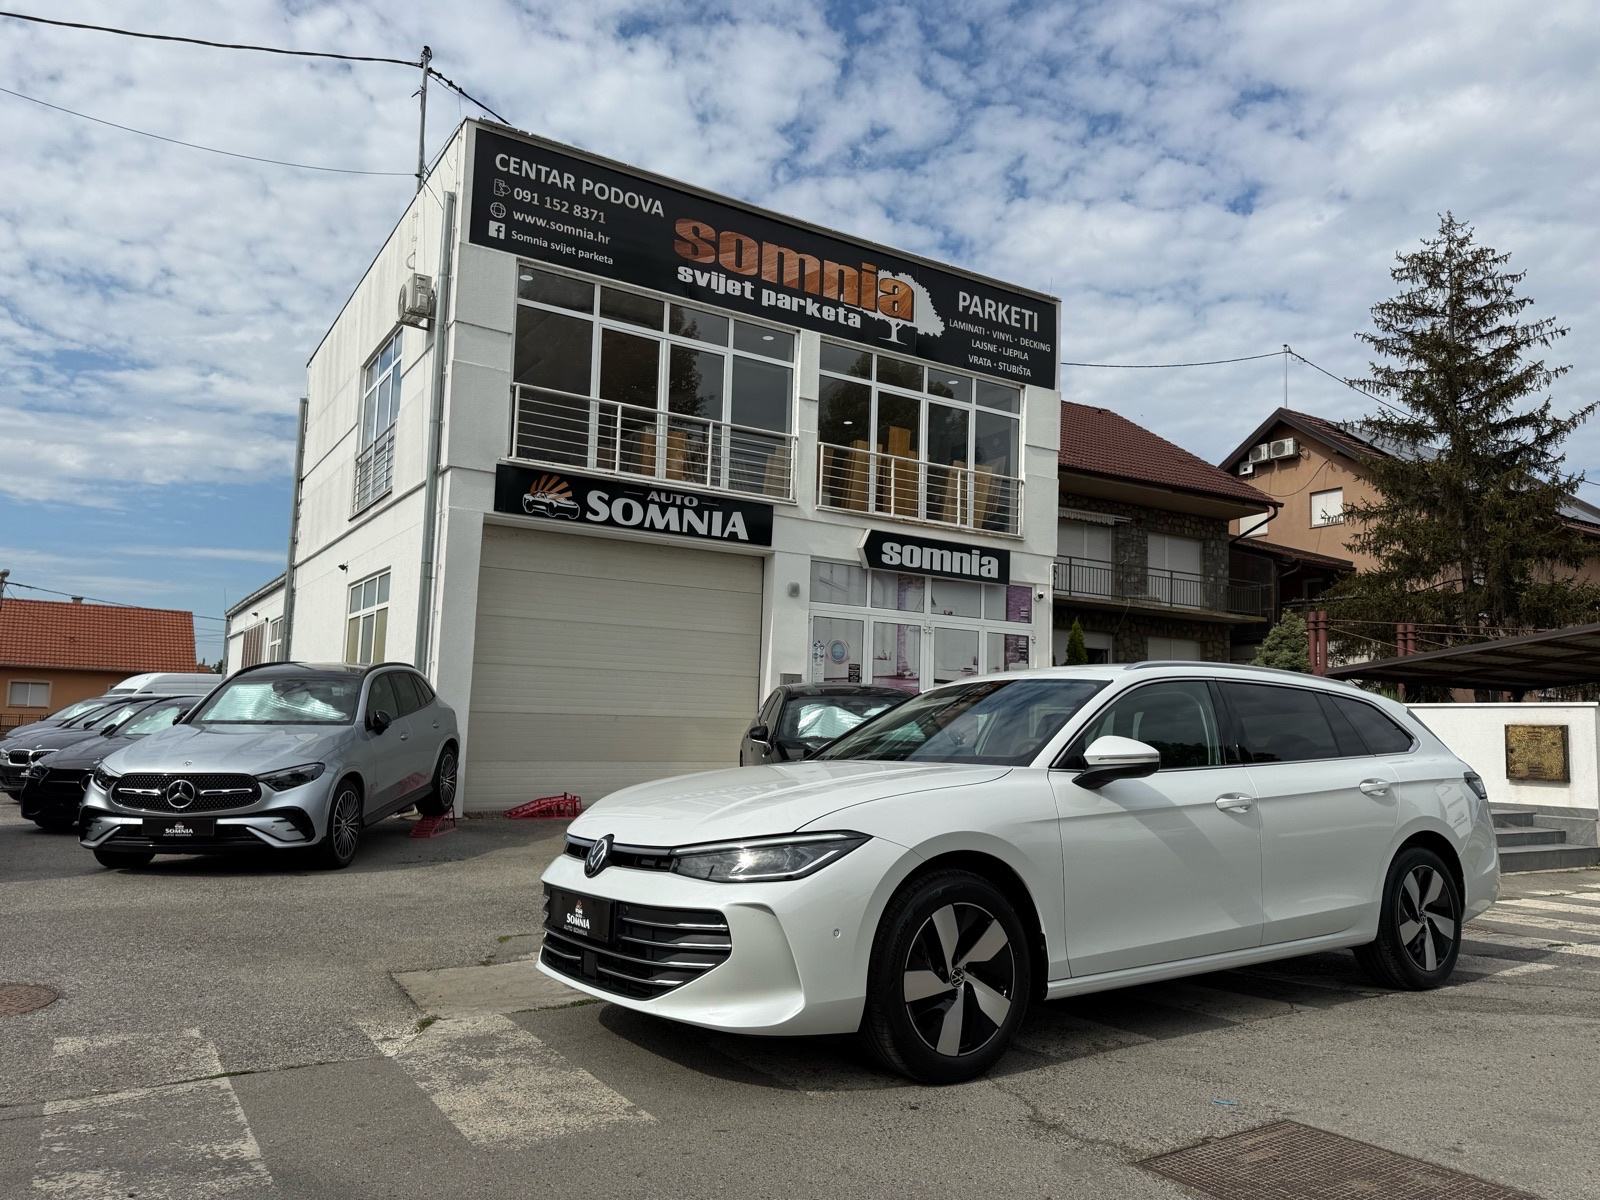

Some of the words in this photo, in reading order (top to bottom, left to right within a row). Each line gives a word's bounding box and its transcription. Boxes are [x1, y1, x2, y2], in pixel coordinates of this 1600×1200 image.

[495, 153, 576, 192] CENTAR
[581, 177, 665, 218] PODOVA
[513, 187, 540, 206] 091
[544, 196, 570, 214] 152
[572, 204, 607, 225] 8371
[512, 210, 611, 245] www.somnia.hr
[511, 230, 549, 248] Somnia
[550, 241, 577, 256] svijet
[578, 247, 614, 265] parketa
[673, 218, 915, 323] somnia
[677, 265, 755, 301] svijet
[761, 288, 862, 329] parketa
[958, 290, 1038, 333] PARKETI
[949, 318, 985, 336] LAMINATI
[991, 329, 1014, 343] VINYL
[1019, 337, 1051, 353] DECKING
[971, 339, 998, 353] LAJSNE
[1002, 346, 1029, 361] LJEPILA
[968, 354, 992, 368] VRATA
[997, 361, 1032, 378] STUBIŠTA
[585, 489, 750, 541] SOMNIA
[646, 490, 699, 507] AUTO
[880, 541, 999, 579] somnia
[566, 912, 590, 930] SOMNIA
